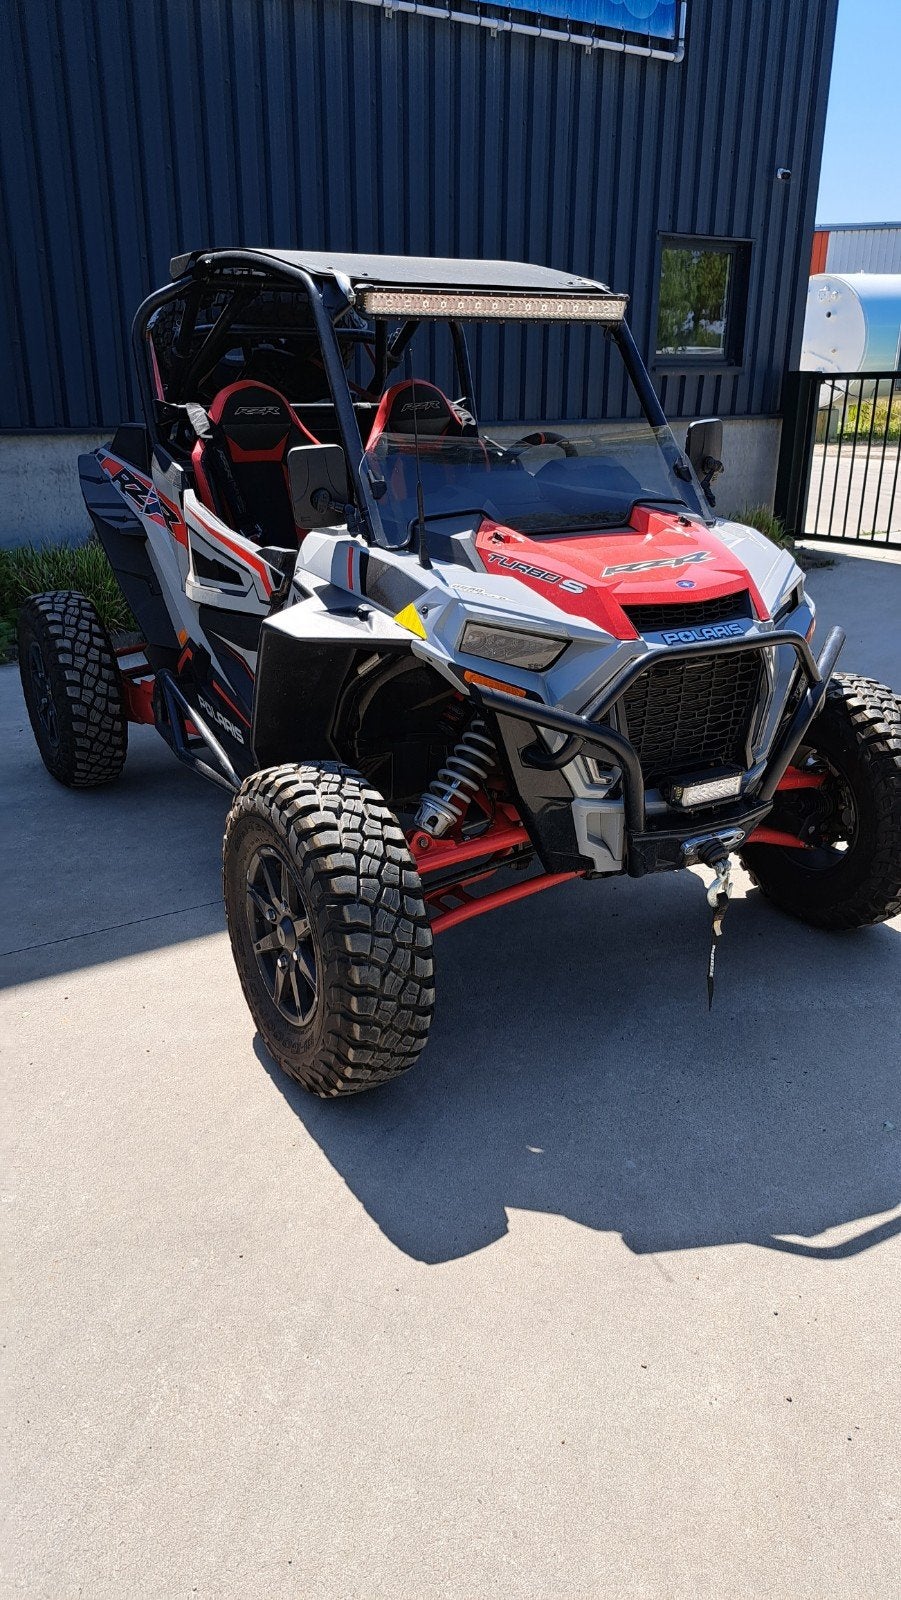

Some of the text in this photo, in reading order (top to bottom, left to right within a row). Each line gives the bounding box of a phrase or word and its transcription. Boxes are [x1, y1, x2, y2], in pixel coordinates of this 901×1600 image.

[234, 406, 280, 415] RZR
[401, 400, 440, 412] RZR
[111, 466, 182, 537] RZR
[487, 552, 588, 594] TURBO S
[601, 550, 716, 578] RZR
[661, 623, 744, 645] POLARIS
[197, 693, 244, 745] POLARIS
